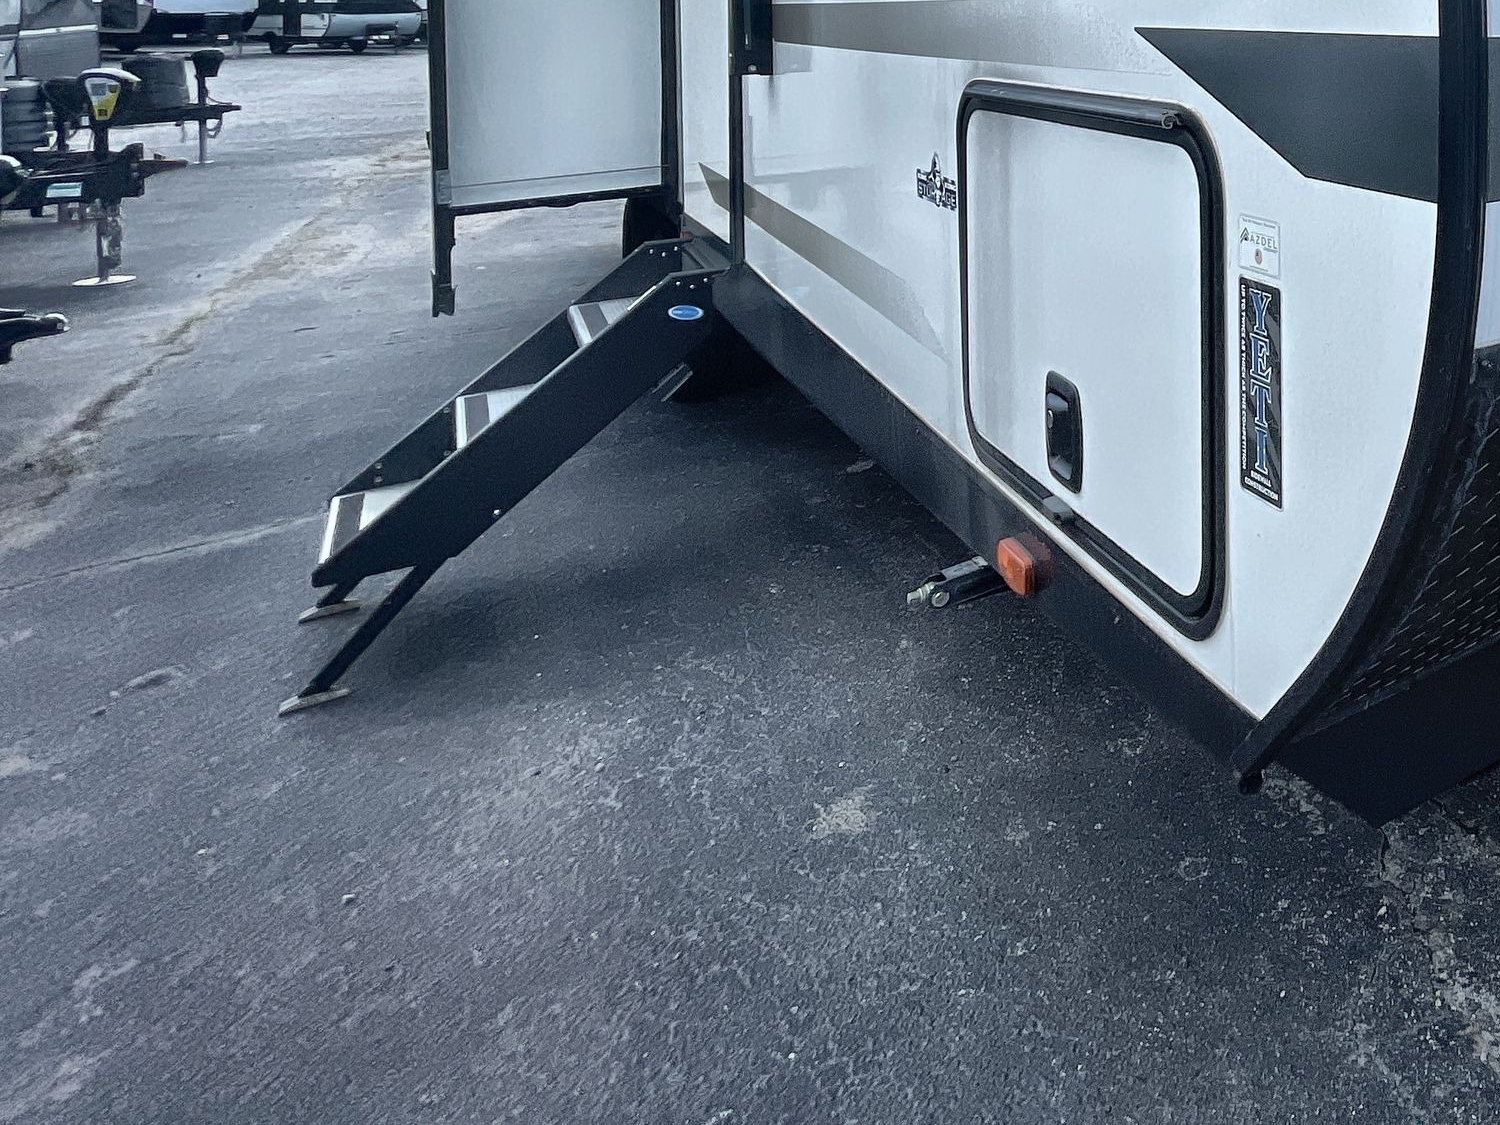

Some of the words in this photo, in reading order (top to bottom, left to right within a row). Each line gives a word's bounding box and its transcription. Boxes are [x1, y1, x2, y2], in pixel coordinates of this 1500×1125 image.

[918, 182, 957, 207] STOAGE
[1250, 234, 1278, 250] AZDEL
[1249, 287, 1272, 475] YETI
